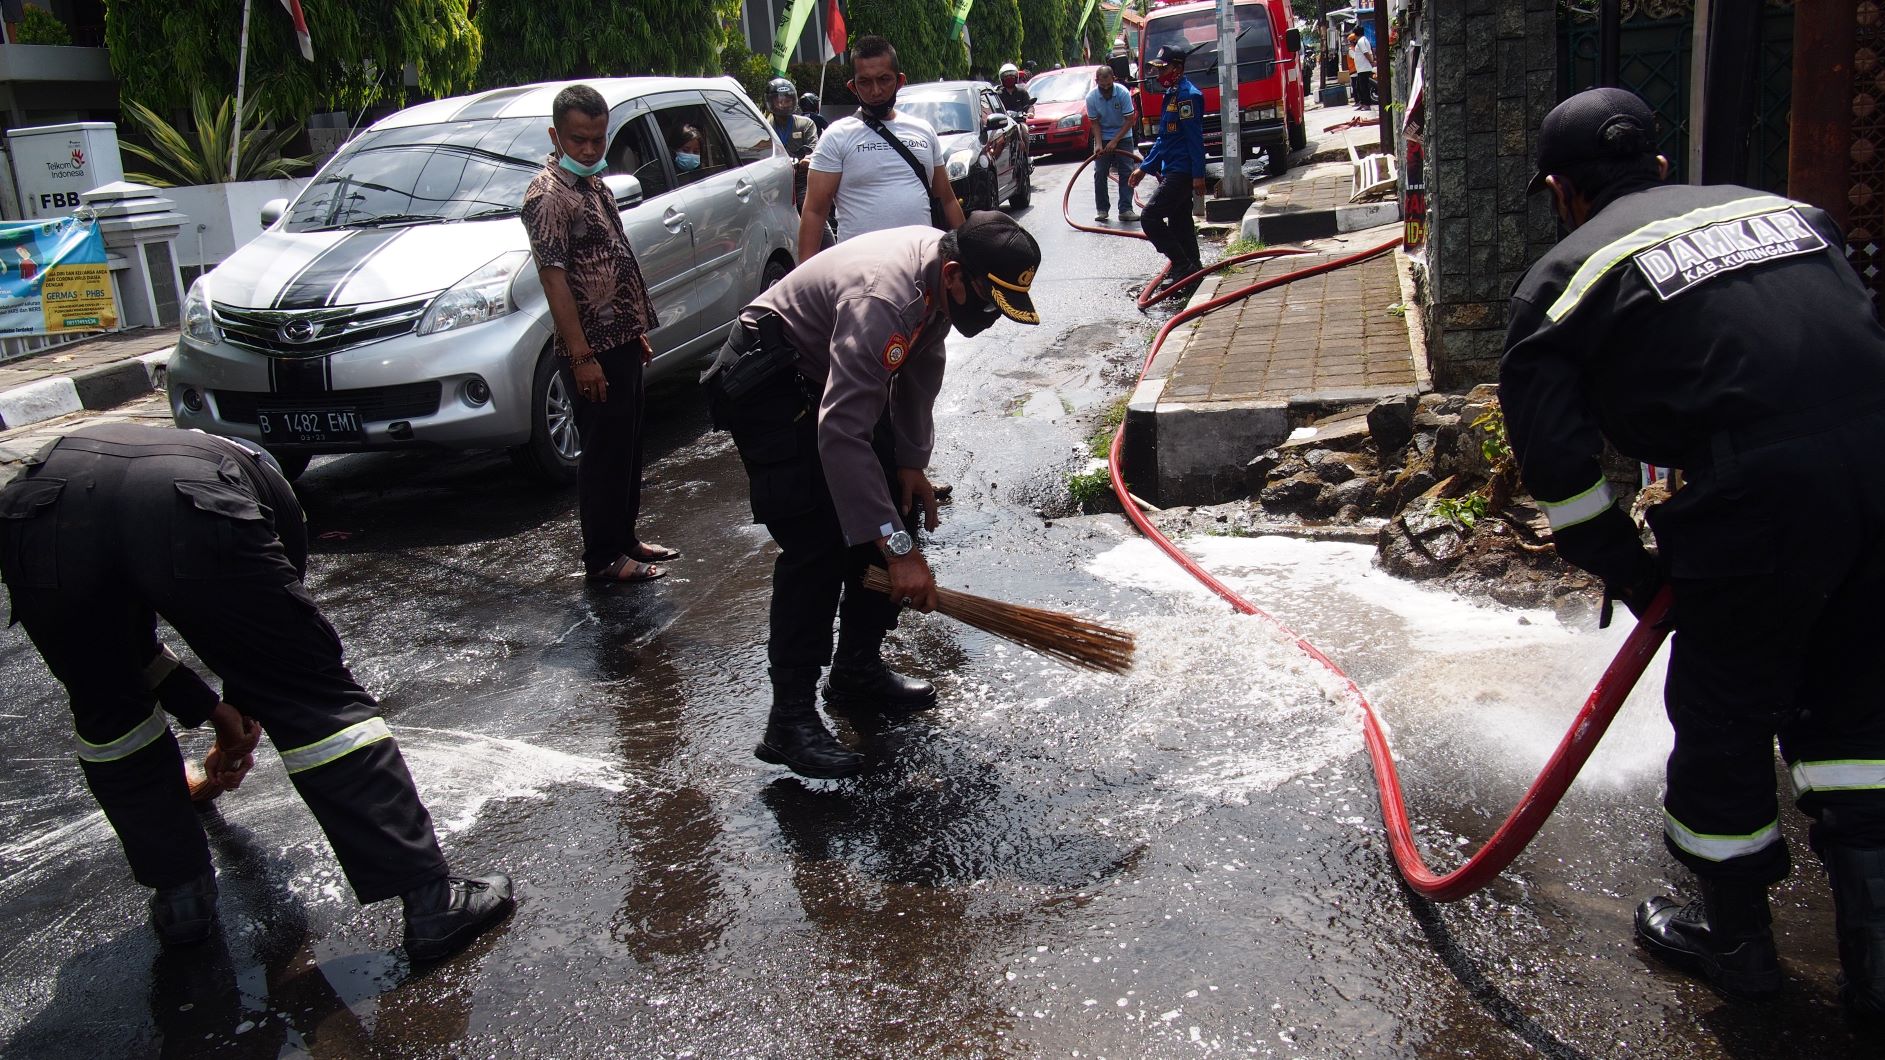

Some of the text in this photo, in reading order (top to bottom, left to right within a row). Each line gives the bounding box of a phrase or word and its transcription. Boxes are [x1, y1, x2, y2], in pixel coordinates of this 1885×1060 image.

[46, 161, 72, 171] Telkom
[51, 170, 85, 179] Indonesia
[40, 191, 80, 209] FBB
[1639, 212, 1813, 284] DAMKAR
[1718, 242, 1799, 268] KUNINGAN
[46, 291, 78, 300] GERMAS
[86, 289, 105, 298] PHBS
[259, 412, 358, 433] B 1482 EMT
